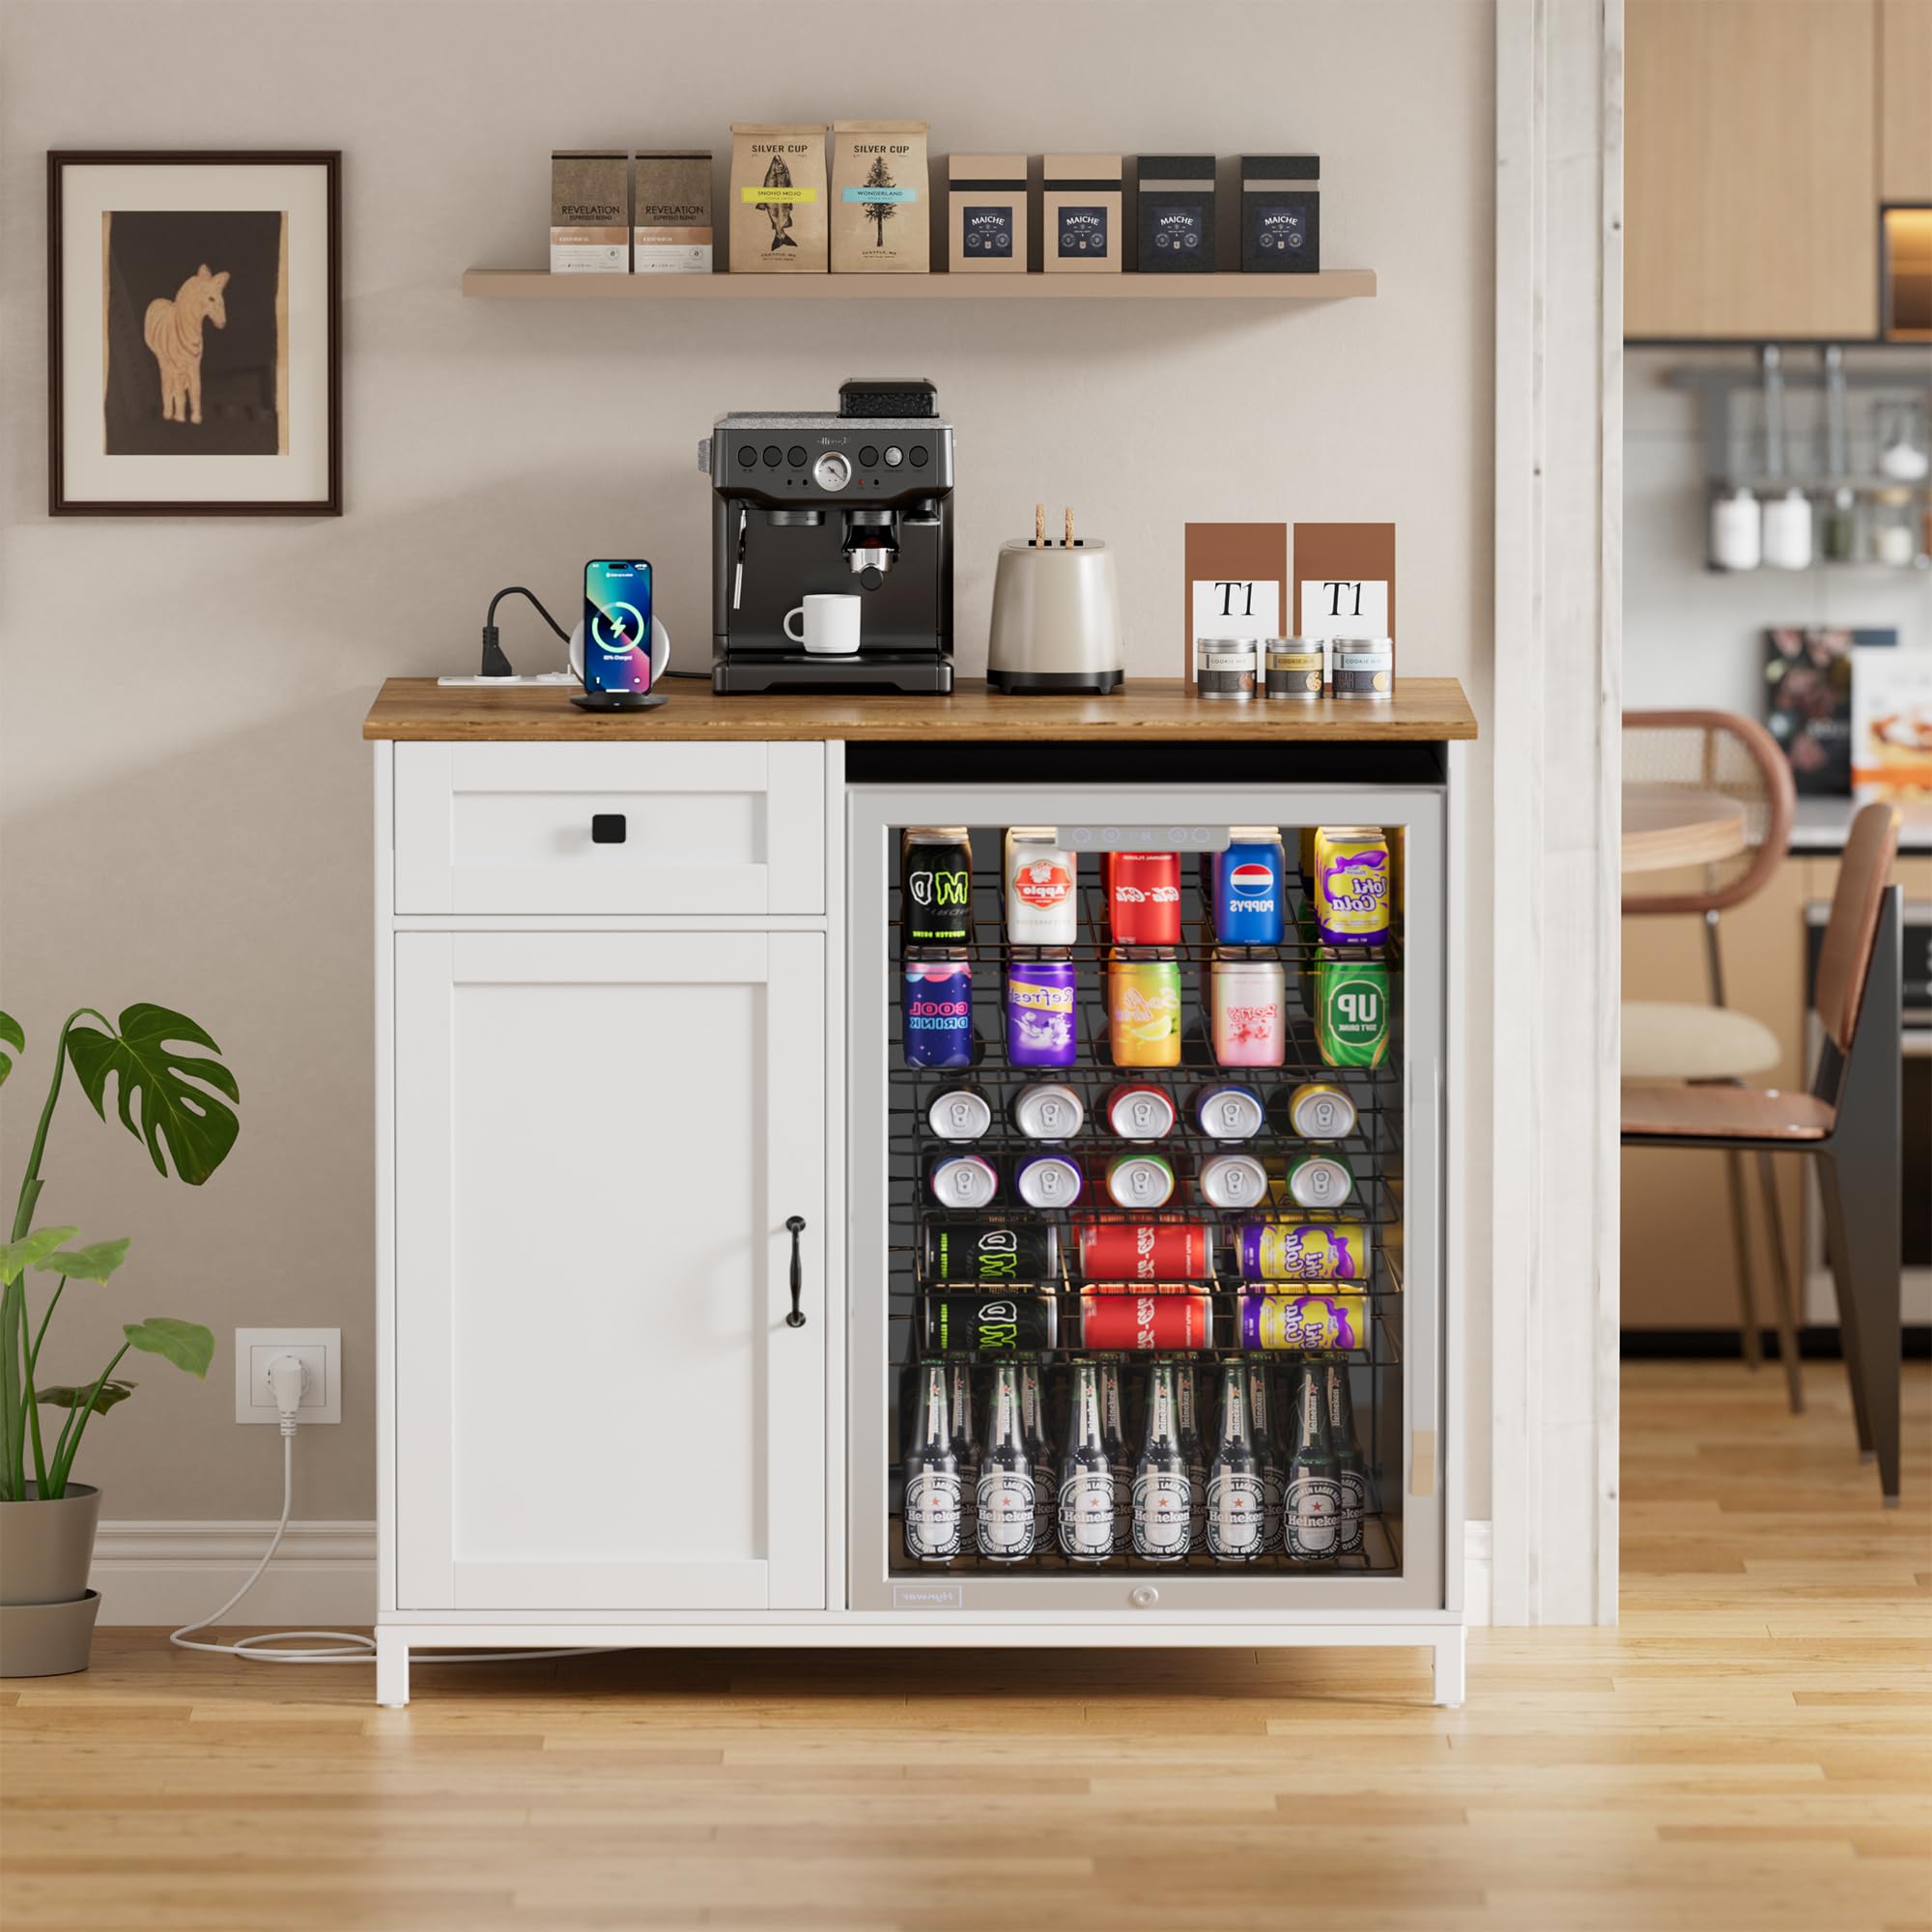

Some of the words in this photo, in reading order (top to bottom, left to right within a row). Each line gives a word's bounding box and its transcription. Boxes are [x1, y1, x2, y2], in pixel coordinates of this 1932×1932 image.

[853, 145, 886, 154] SILVER
[890, 145, 910, 154] CUP
[561, 206, 620, 214] REVELATION
[645, 206, 704, 214] REVELATION
[971, 215, 1006, 225] MAICHE
[1065, 215, 1100, 225] MAICHE
[1159, 215, 1194, 226] MAICHE
[1264, 215, 1298, 226] MAICHE
[1213, 582, 1256, 616] T1
[1322, 582, 1364, 616] T1
[1181, 1391, 1190, 1428] Heineken
[979, 1508, 1035, 1522] Heineken
[1065, 1511, 1114, 1522] Heineke
[1134, 1510, 1190, 1522] Heineken
[1008, 1531, 1032, 1553] QUALITY
[1164, 1532, 1188, 1553] QUALITY
[1239, 1532, 1263, 1554] QUALITY
